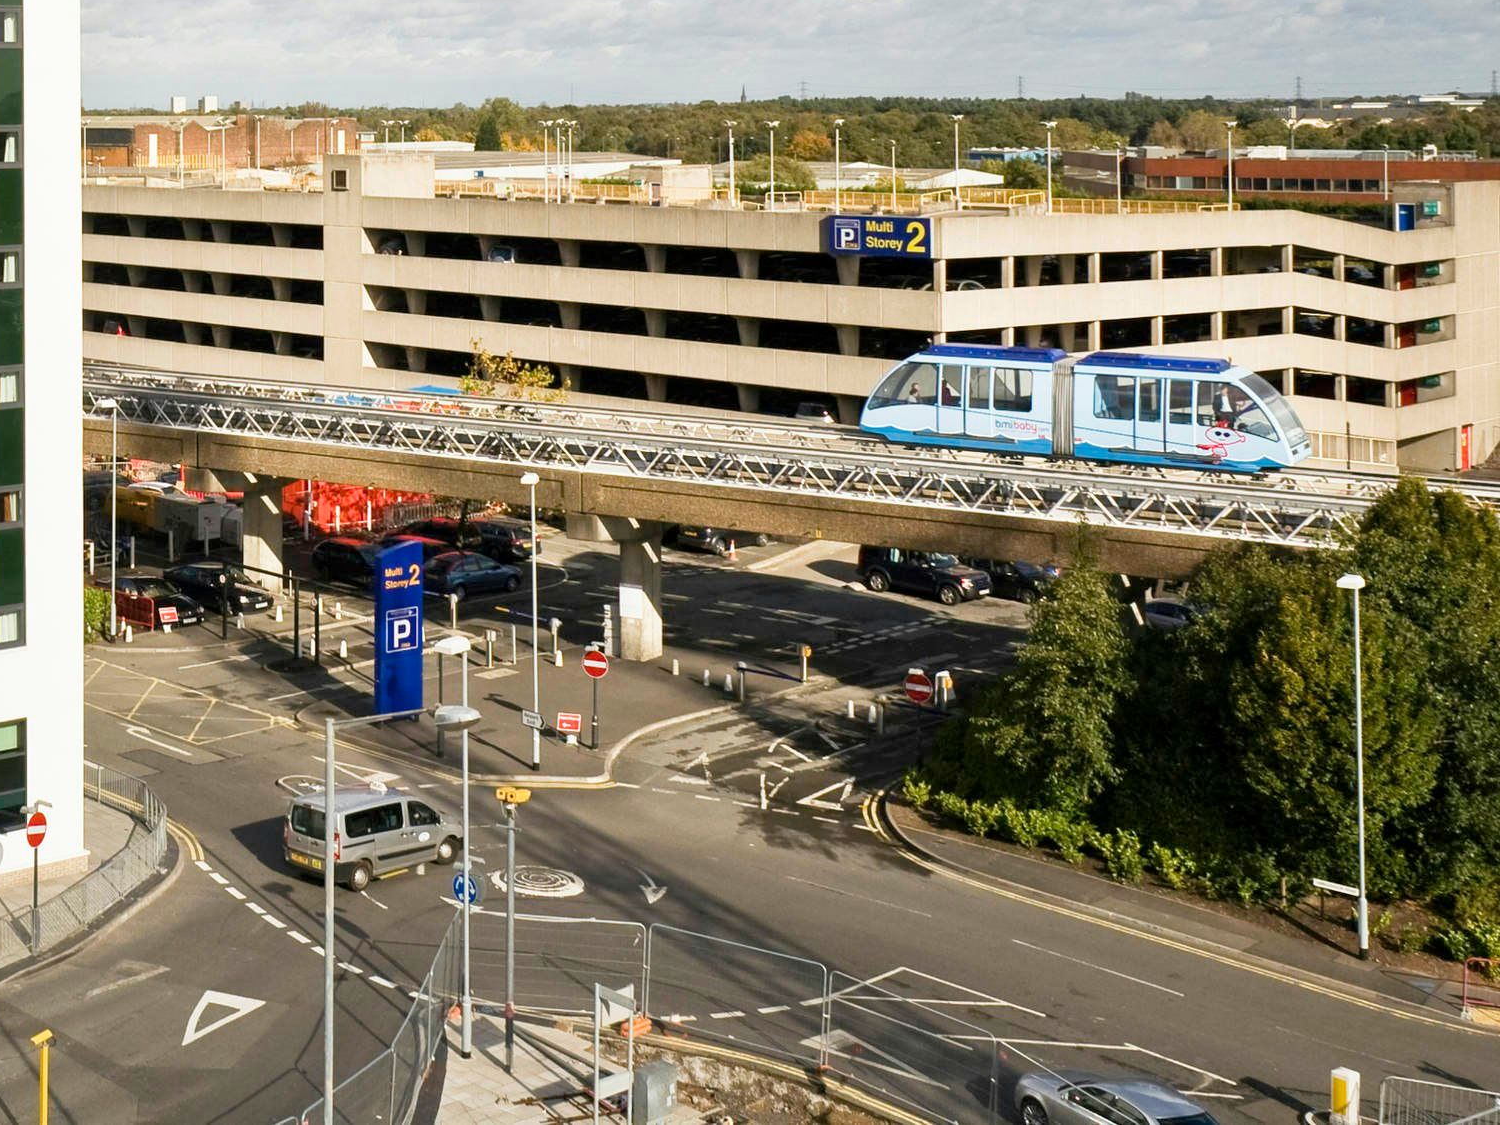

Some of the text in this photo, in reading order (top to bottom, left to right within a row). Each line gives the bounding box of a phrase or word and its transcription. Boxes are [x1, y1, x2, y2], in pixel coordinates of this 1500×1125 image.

[840, 228, 855, 248] P
[865, 220, 926, 253] Multi 2
[865, 235, 903, 252] Storey
[384, 563, 421, 586] Multi 2
[384, 578, 408, 590] Storey
[393, 618, 411, 649] P
